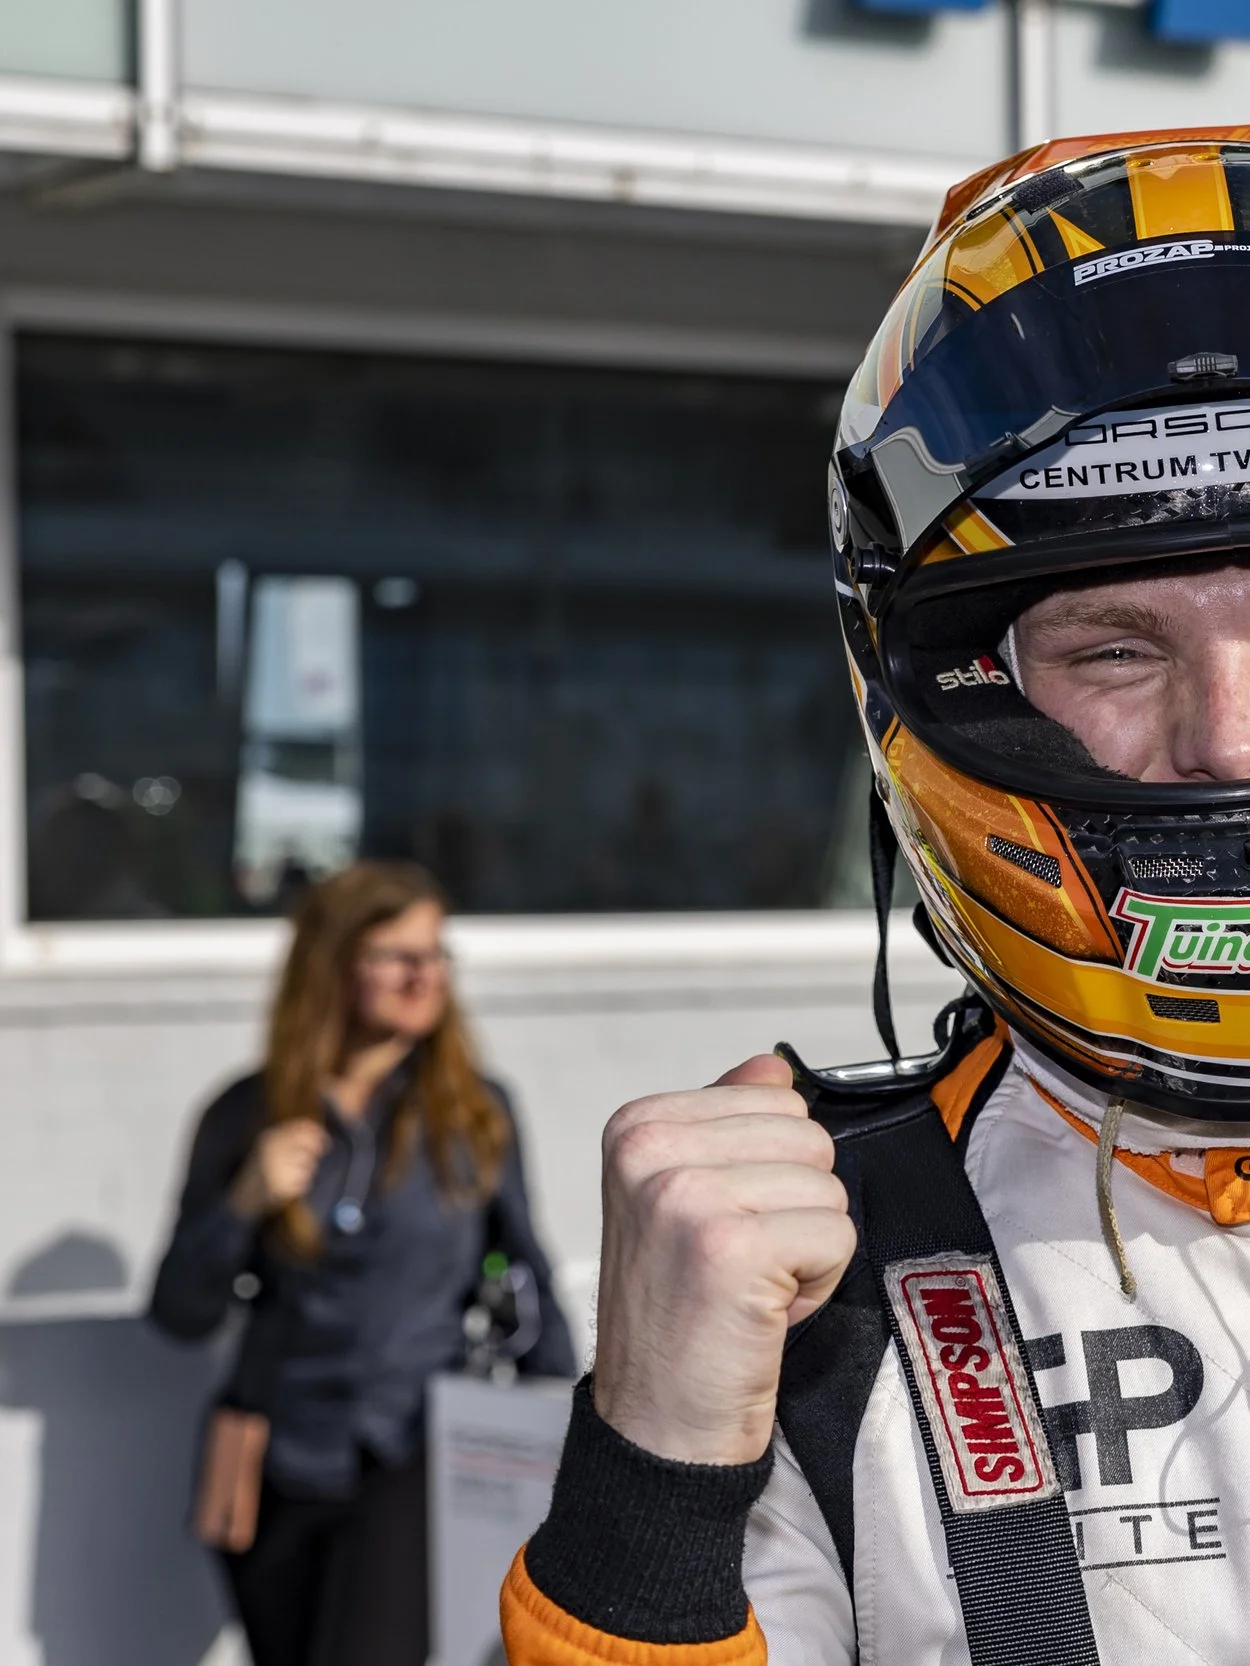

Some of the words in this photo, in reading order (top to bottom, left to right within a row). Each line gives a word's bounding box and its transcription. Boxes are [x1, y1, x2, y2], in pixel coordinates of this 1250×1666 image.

[1074, 240, 1215, 286] PROZAP
[1018, 456, 1199, 490] CENTRUM
[936, 655, 1010, 691] stilo
[919, 1287, 1025, 1483] SIMPSON
[1074, 1508, 1223, 1561] ITE
